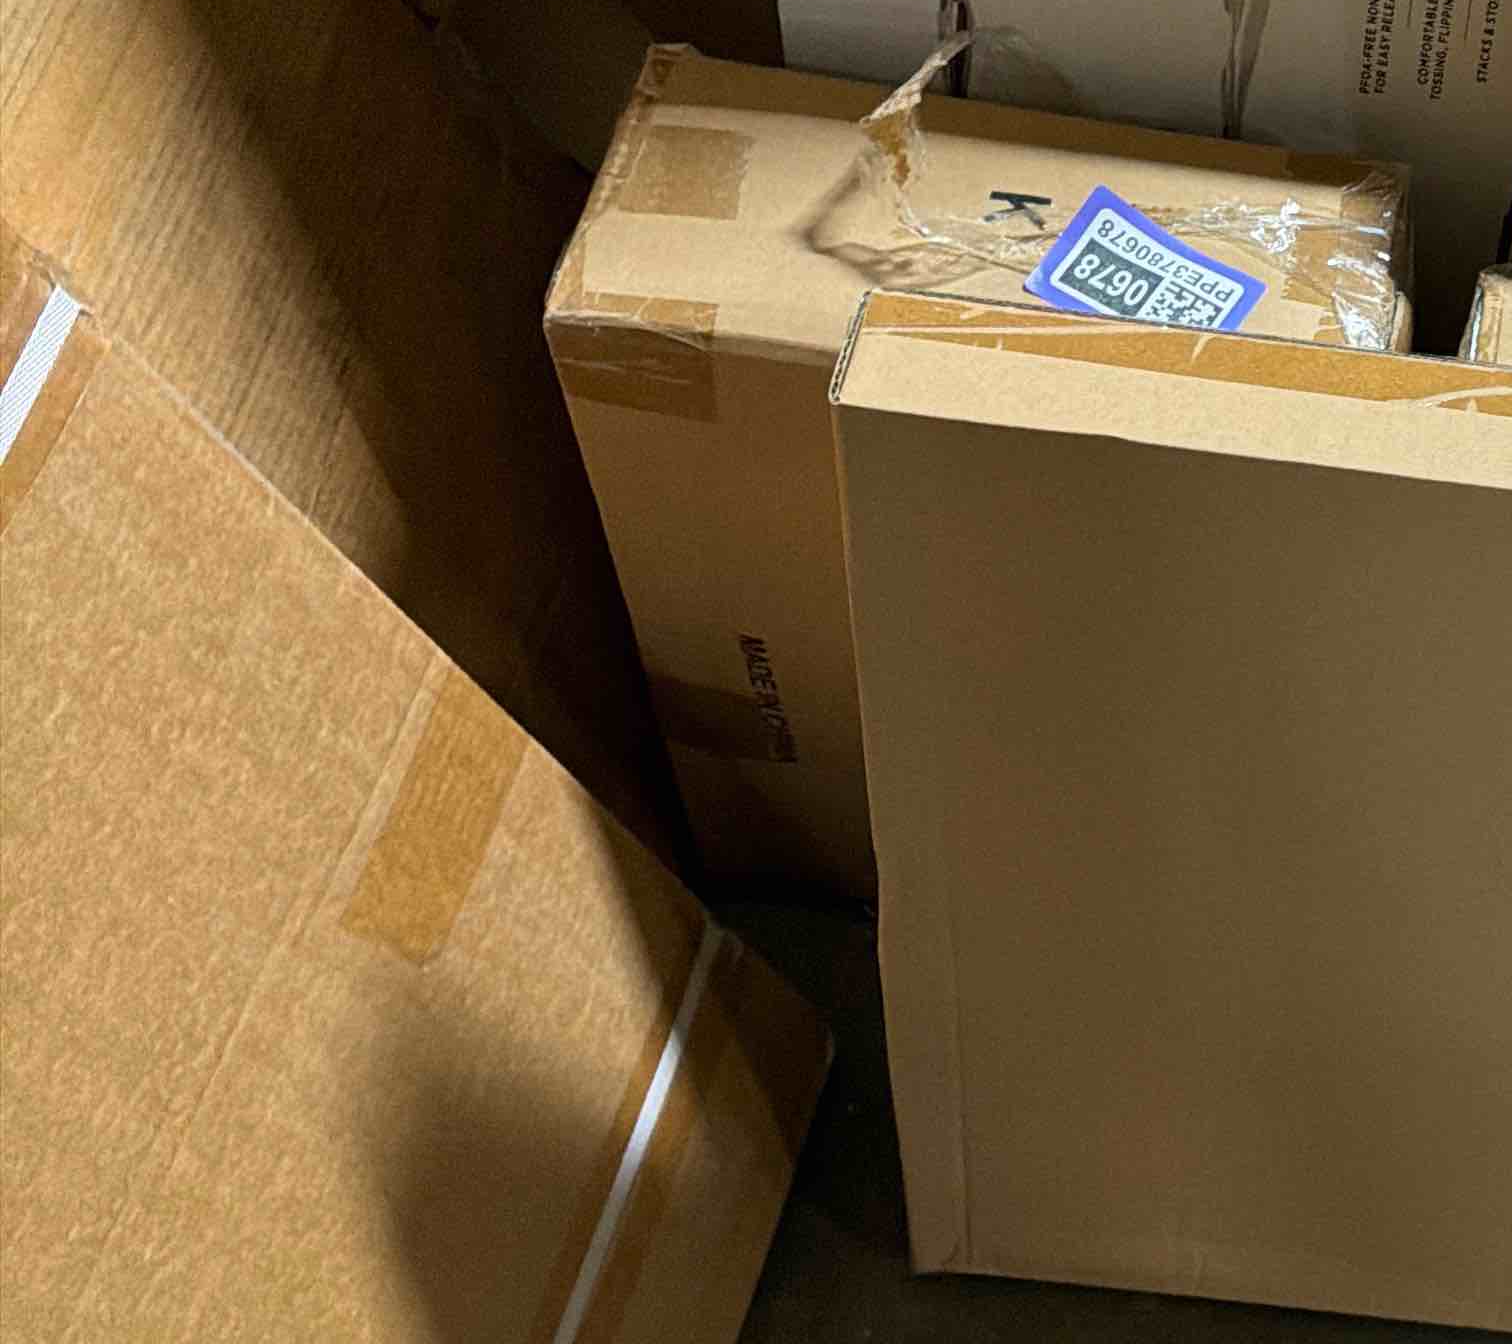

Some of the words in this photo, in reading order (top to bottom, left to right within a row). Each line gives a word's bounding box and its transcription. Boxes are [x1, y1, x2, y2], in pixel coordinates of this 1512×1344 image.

[1378, 35, 1392, 68] EASY
[1476, 39, 1494, 84] STACKS
[1374, 69, 1388, 94] FOR
[1073, 253, 1150, 306] 0678
[1097, 218, 1236, 304] PPE3780678
